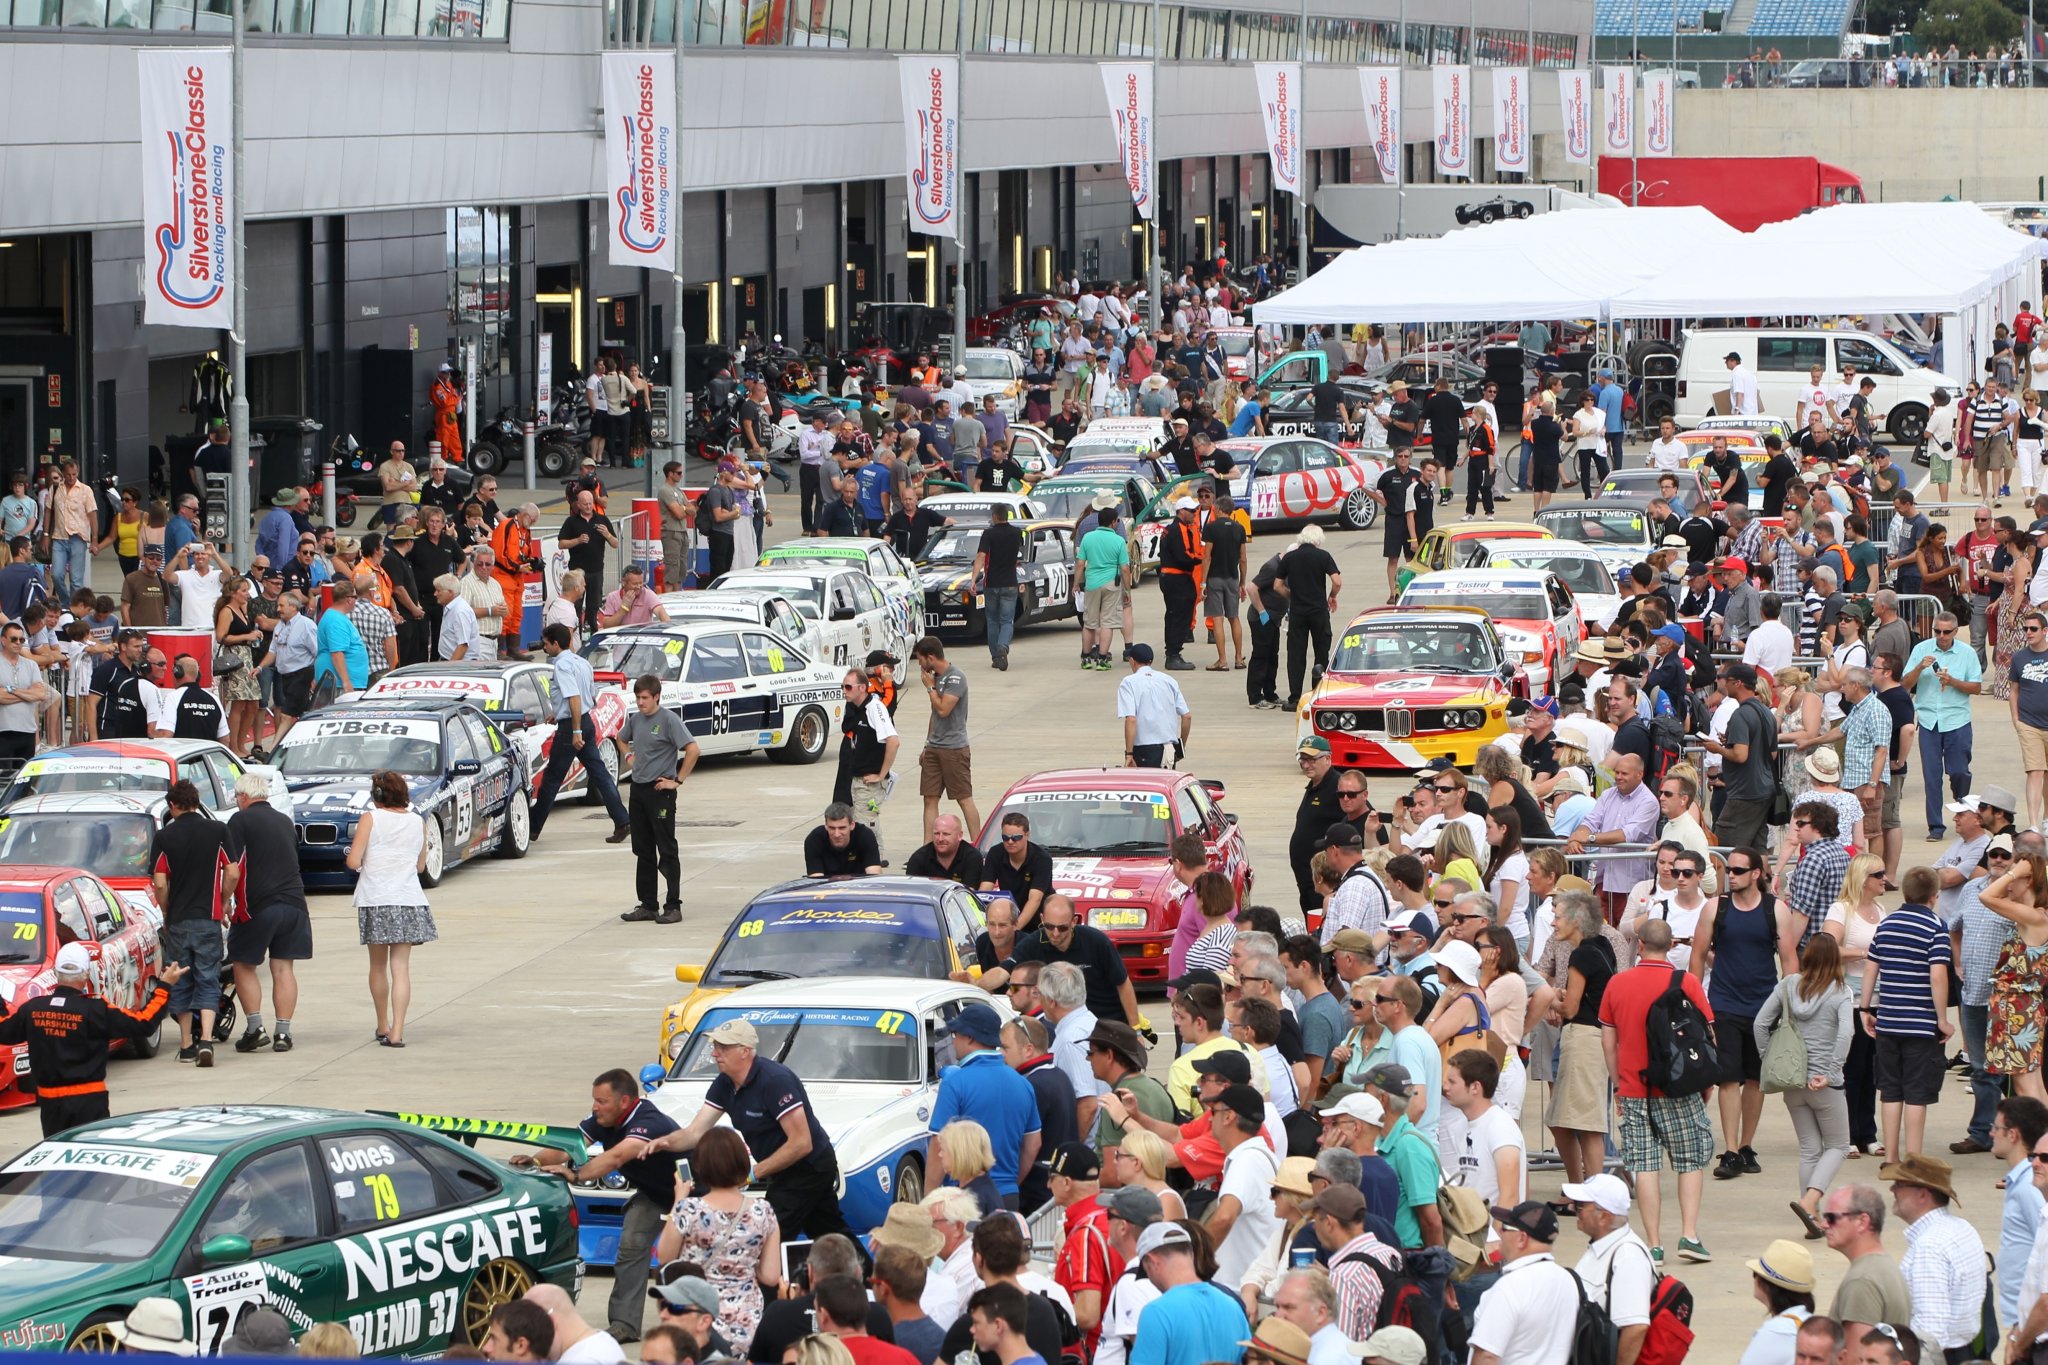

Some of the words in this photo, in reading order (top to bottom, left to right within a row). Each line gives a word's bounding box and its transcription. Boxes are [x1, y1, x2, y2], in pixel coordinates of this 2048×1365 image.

[928, 67, 943, 206] SilverstoneClassic
[637, 64, 655, 233] SilverstoneClassic
[184, 65, 210, 281] SilverstoneClassic
[657, 126, 670, 235] RockingandRacing
[211, 144, 226, 284] RockingandRacing
[1307, 456, 1327, 466] Stuck
[1033, 487, 1090, 497] PEUGEOT
[954, 503, 991, 511] SHIPPI
[1257, 493, 1276, 518] 44
[1542, 511, 1579, 520] TRIPLEX
[1495, 551, 1550, 560] SILVERSTONE
[1551, 551, 1594, 559] AUCTIONS
[1053, 567, 1068, 600] 20
[1456, 581, 1490, 589] Castrol
[689, 604, 744, 612] EUROTEAM
[1343, 634, 1360, 650] 93
[767, 648, 785, 673] 60
[813, 672, 835, 682] Shell
[376, 680, 493, 694] HONDA
[780, 690, 846, 704] EUROPA-MOB
[183, 702, 216, 711] SUB-ZERO
[341, 721, 409, 735] Beta
[1023, 793, 1147, 803] BROOKLYN
[1152, 804, 1170, 820] 15
[781, 909, 896, 920] Mondeo
[1098, 911, 1140, 924] Hella
[13, 923, 38, 940] 70
[738, 920, 765, 938] 68
[32, 1011, 83, 1023] SILVERSTONE
[34, 1019, 78, 1030] MARSHALS
[841, 1014, 870, 1022] RACING
[875, 1011, 905, 1035] 47
[44, 1028, 67, 1038] TEAM
[24, 1155, 48, 1167] 37
[53, 1148, 163, 1171] NESCAFÉ
[330, 1144, 395, 1174] Jones
[169, 1164, 195, 1177] 37
[363, 1173, 400, 1221] 79
[334, 1192, 547, 1300] NESCAFÉ
[206, 1270, 249, 1286] Auto
[262, 1261, 304, 1294] www.
[193, 1278, 264, 1299] Trader
[348, 1298, 422, 1356] BLEND
[428, 1287, 459, 1337] 37
[2, 1319, 66, 1350] FUJITSU
